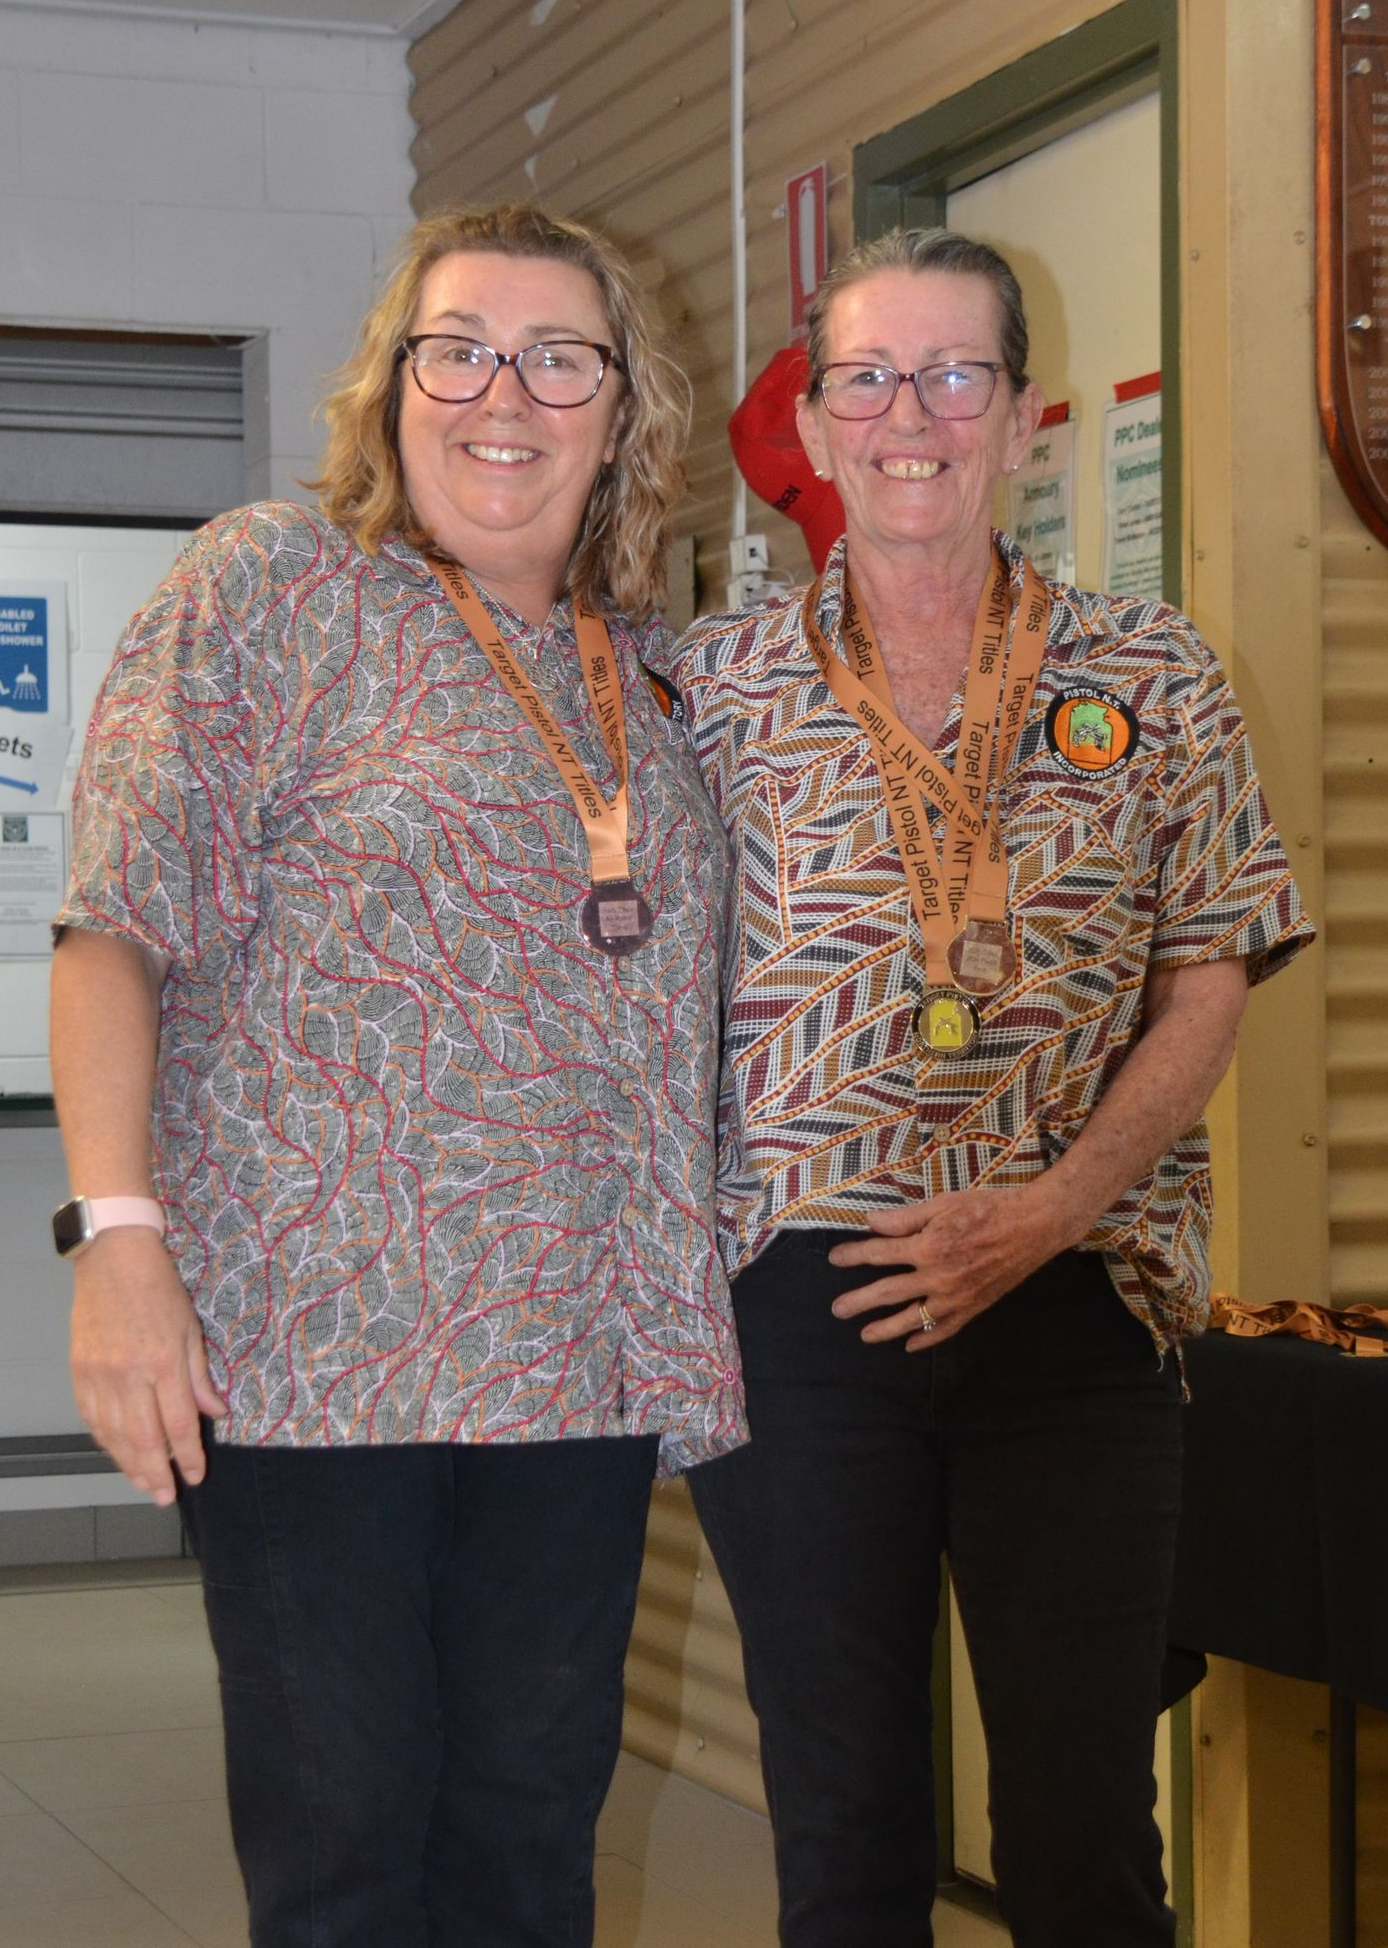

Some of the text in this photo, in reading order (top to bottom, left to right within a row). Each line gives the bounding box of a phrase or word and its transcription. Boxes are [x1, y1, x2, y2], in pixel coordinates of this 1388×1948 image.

[1114, 423, 1135, 447] PPC
[437, 562, 470, 601] Titles
[0, 608, 35, 621] ABLED
[0, 621, 28, 633] OILET
[986, 606, 1007, 631] NT
[1026, 594, 1049, 634] Titles
[849, 627, 876, 682] Target
[978, 634, 1003, 676] Titles
[590, 655, 611, 698] Titles
[1063, 687, 1101, 701] PISTOL
[597, 698, 616, 725] NT
[1006, 672, 1035, 730] Target
[486, 638, 602, 819] Target Pistol NT Titles
[856, 700, 894, 748] Titles
[0, 736, 33, 759] ets
[889, 742, 919, 772] NT
[962, 721, 990, 781] Target
[1053, 751, 1127, 781] INCORPORATED
[913, 764, 958, 815] Pistol
[886, 774, 942, 922] Target Pistol NT
[952, 840, 975, 868] NT
